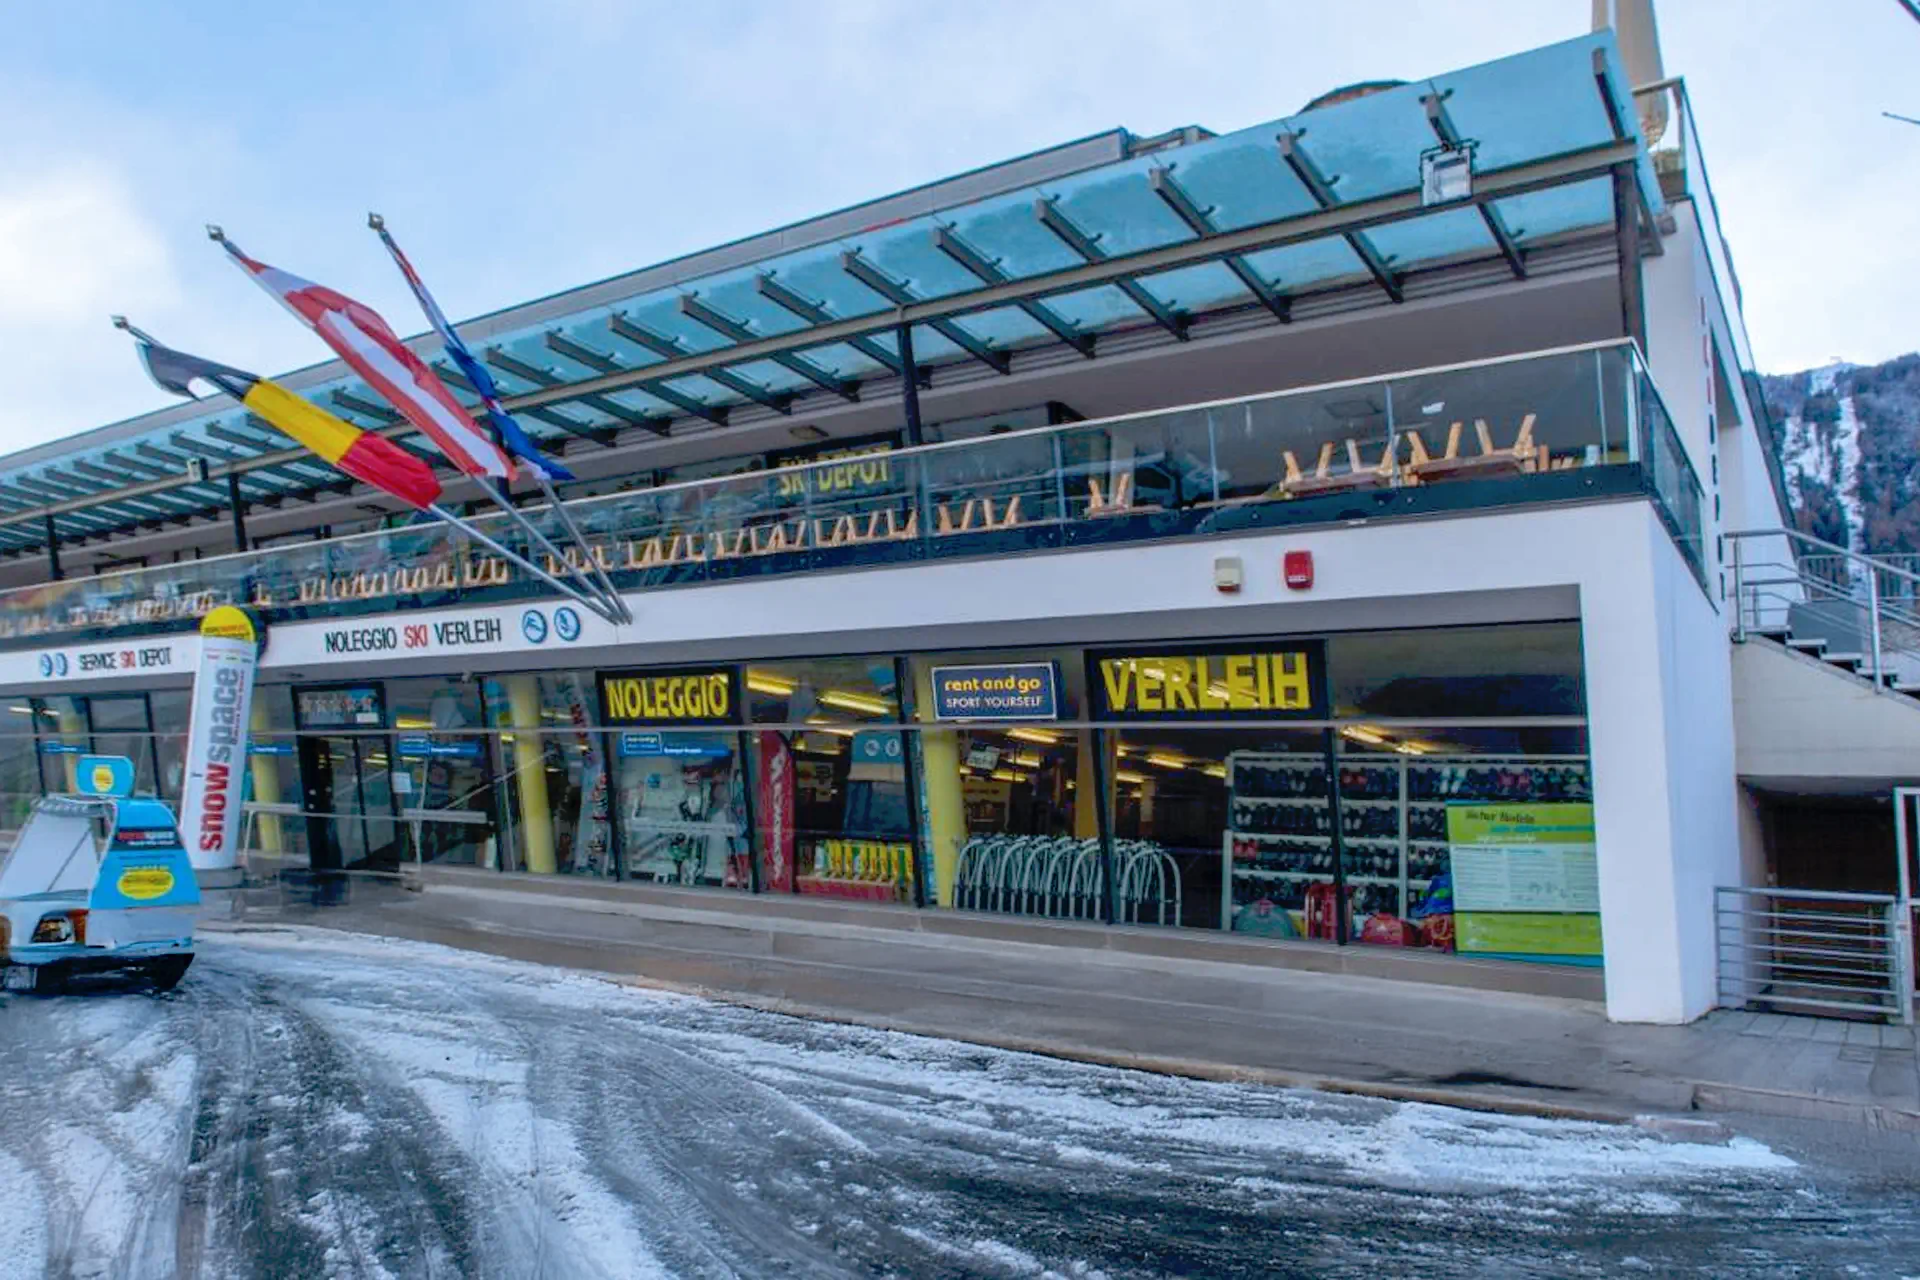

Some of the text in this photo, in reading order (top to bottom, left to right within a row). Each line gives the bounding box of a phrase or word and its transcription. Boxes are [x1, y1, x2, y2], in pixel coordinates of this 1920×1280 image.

[325, 619, 502, 653] NOLEGGIO SKI VERLEIH
[138, 647, 172, 667] DEPOT
[604, 673, 729, 718] NOLEGGIO
[944, 674, 1041, 694] rent and go
[1099, 652, 1311, 711] VERLEIH
[946, 695, 1042, 708] SPORT YOURSELF
[199, 667, 238, 851] snowspace
